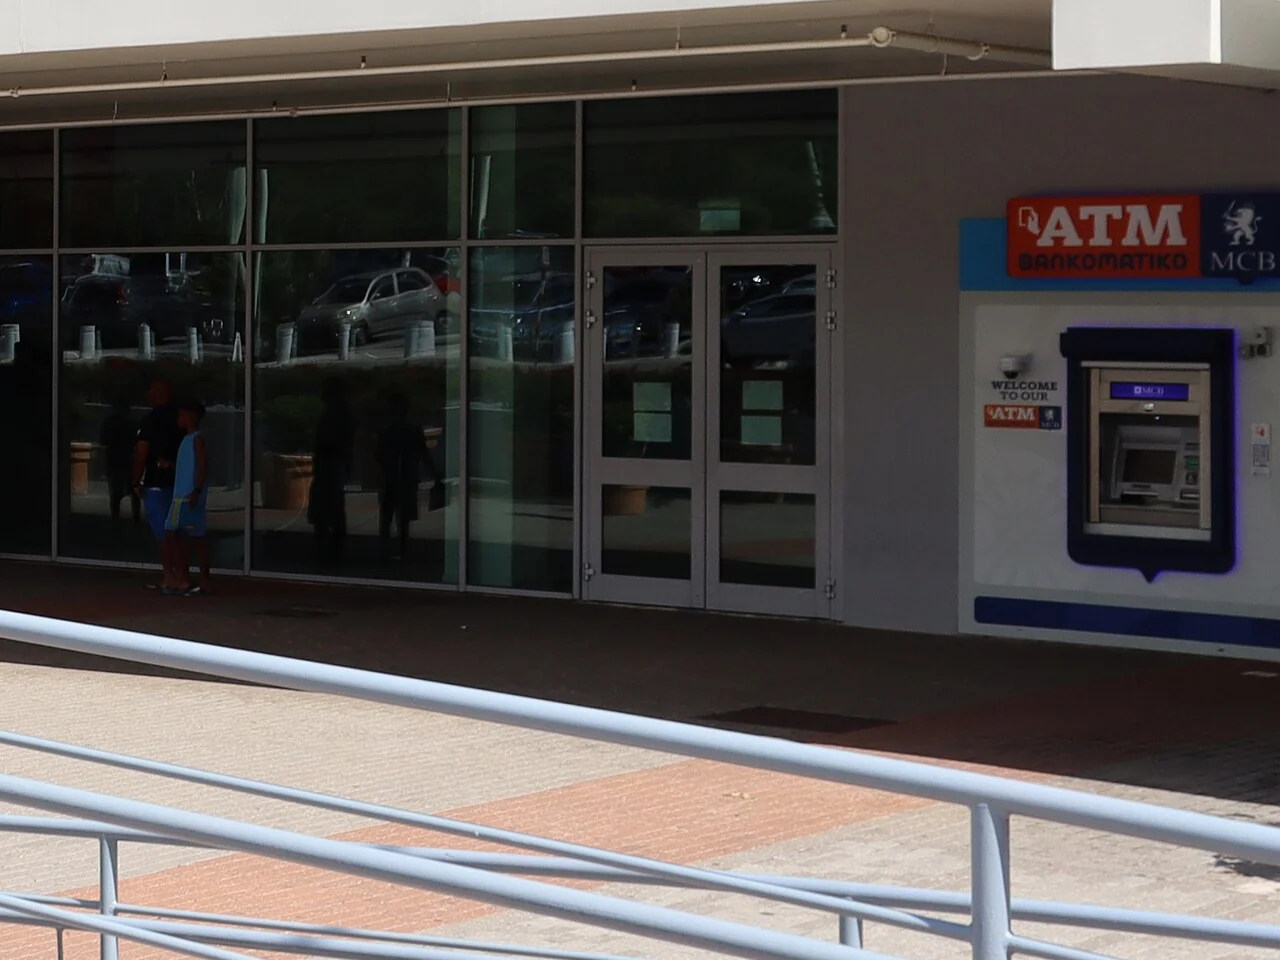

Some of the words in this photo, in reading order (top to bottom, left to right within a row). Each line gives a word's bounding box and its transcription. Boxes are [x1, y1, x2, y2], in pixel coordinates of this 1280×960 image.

[1036, 204, 1187, 247] ATM
[1019, 251, 1188, 271] BANKOMATIKO
[1210, 251, 1277, 272] MCB
[991, 380, 1058, 391] WELCOME
[1000, 391, 1018, 400] TO
[1021, 391, 1049, 401] OUR
[992, 406, 1036, 421] ATM
